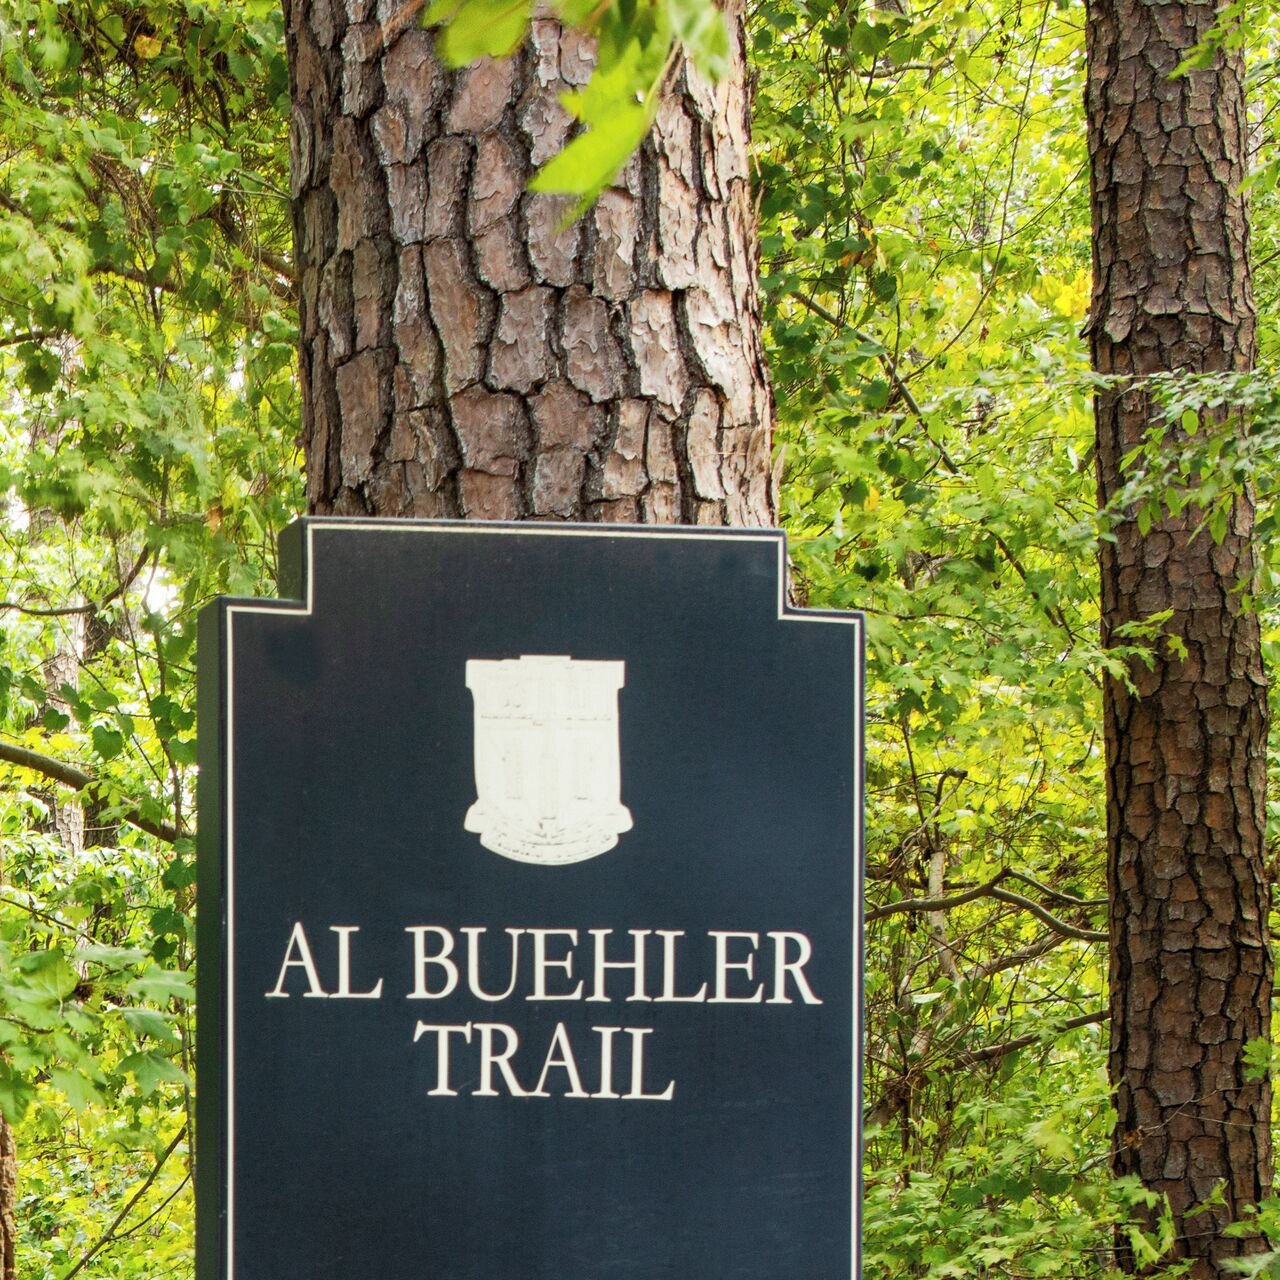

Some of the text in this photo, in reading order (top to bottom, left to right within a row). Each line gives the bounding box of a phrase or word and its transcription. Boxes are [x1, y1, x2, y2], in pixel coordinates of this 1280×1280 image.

[264, 921, 823, 1005] AL BUEHLER
[413, 1020, 676, 1101] TRAIL
